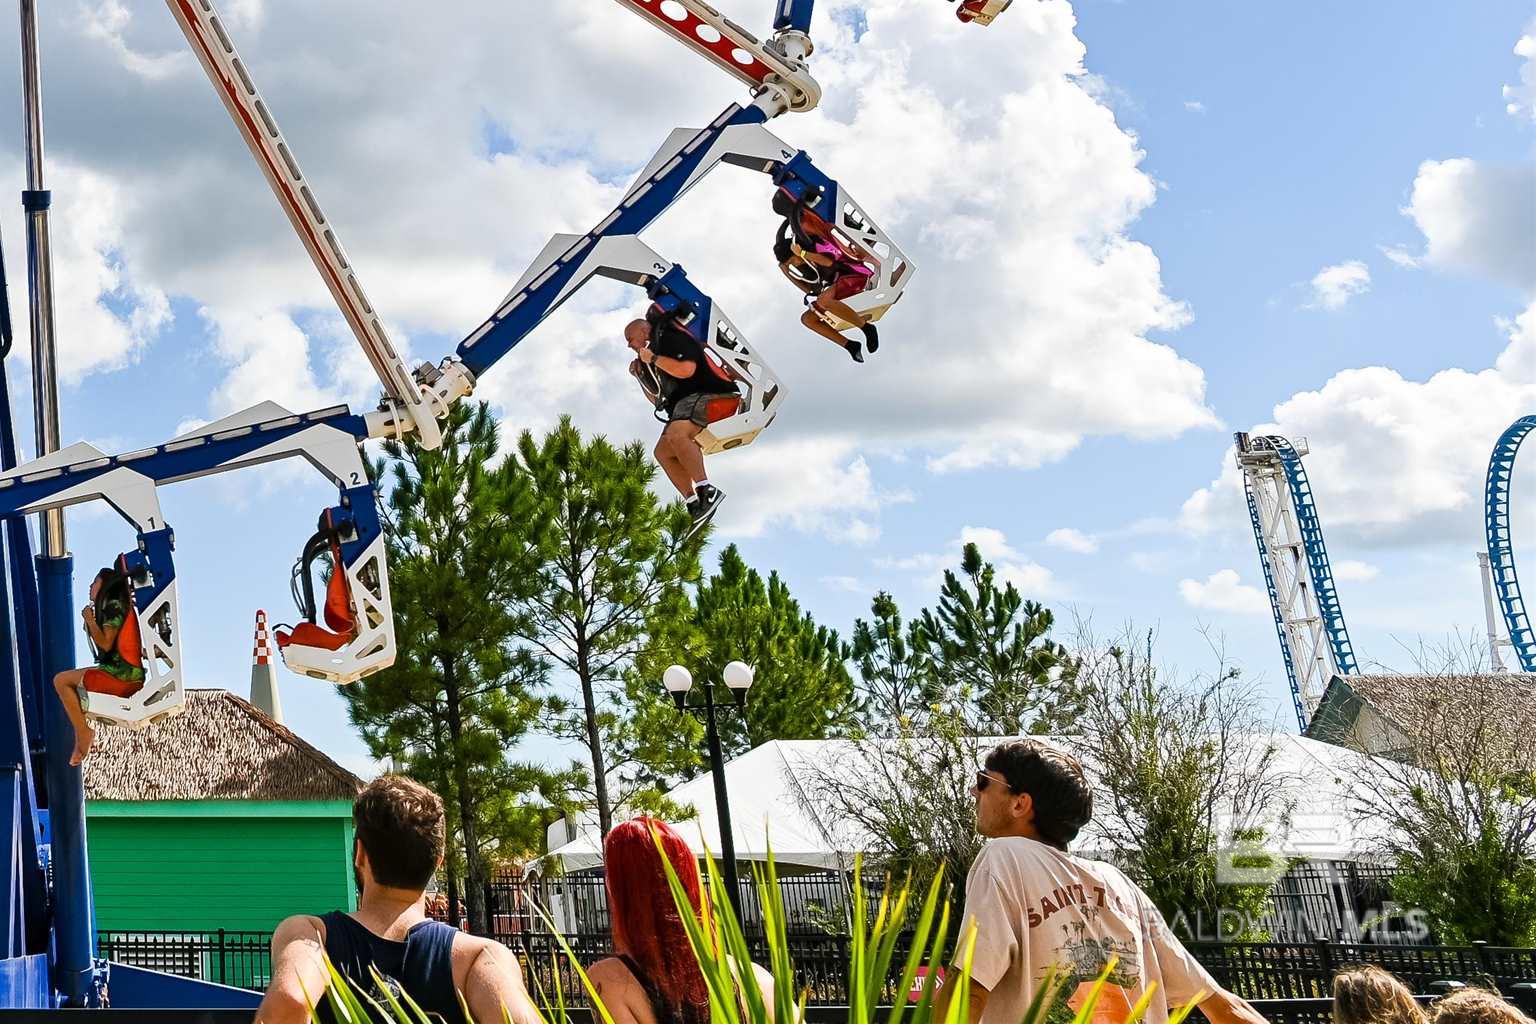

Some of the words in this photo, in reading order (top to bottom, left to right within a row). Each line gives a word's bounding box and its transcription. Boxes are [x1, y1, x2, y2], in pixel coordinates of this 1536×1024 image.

[780, 149, 793, 159] 4
[653, 262, 667, 274] 3
[349, 471, 361, 486] 2
[147, 516, 156, 530] 1
